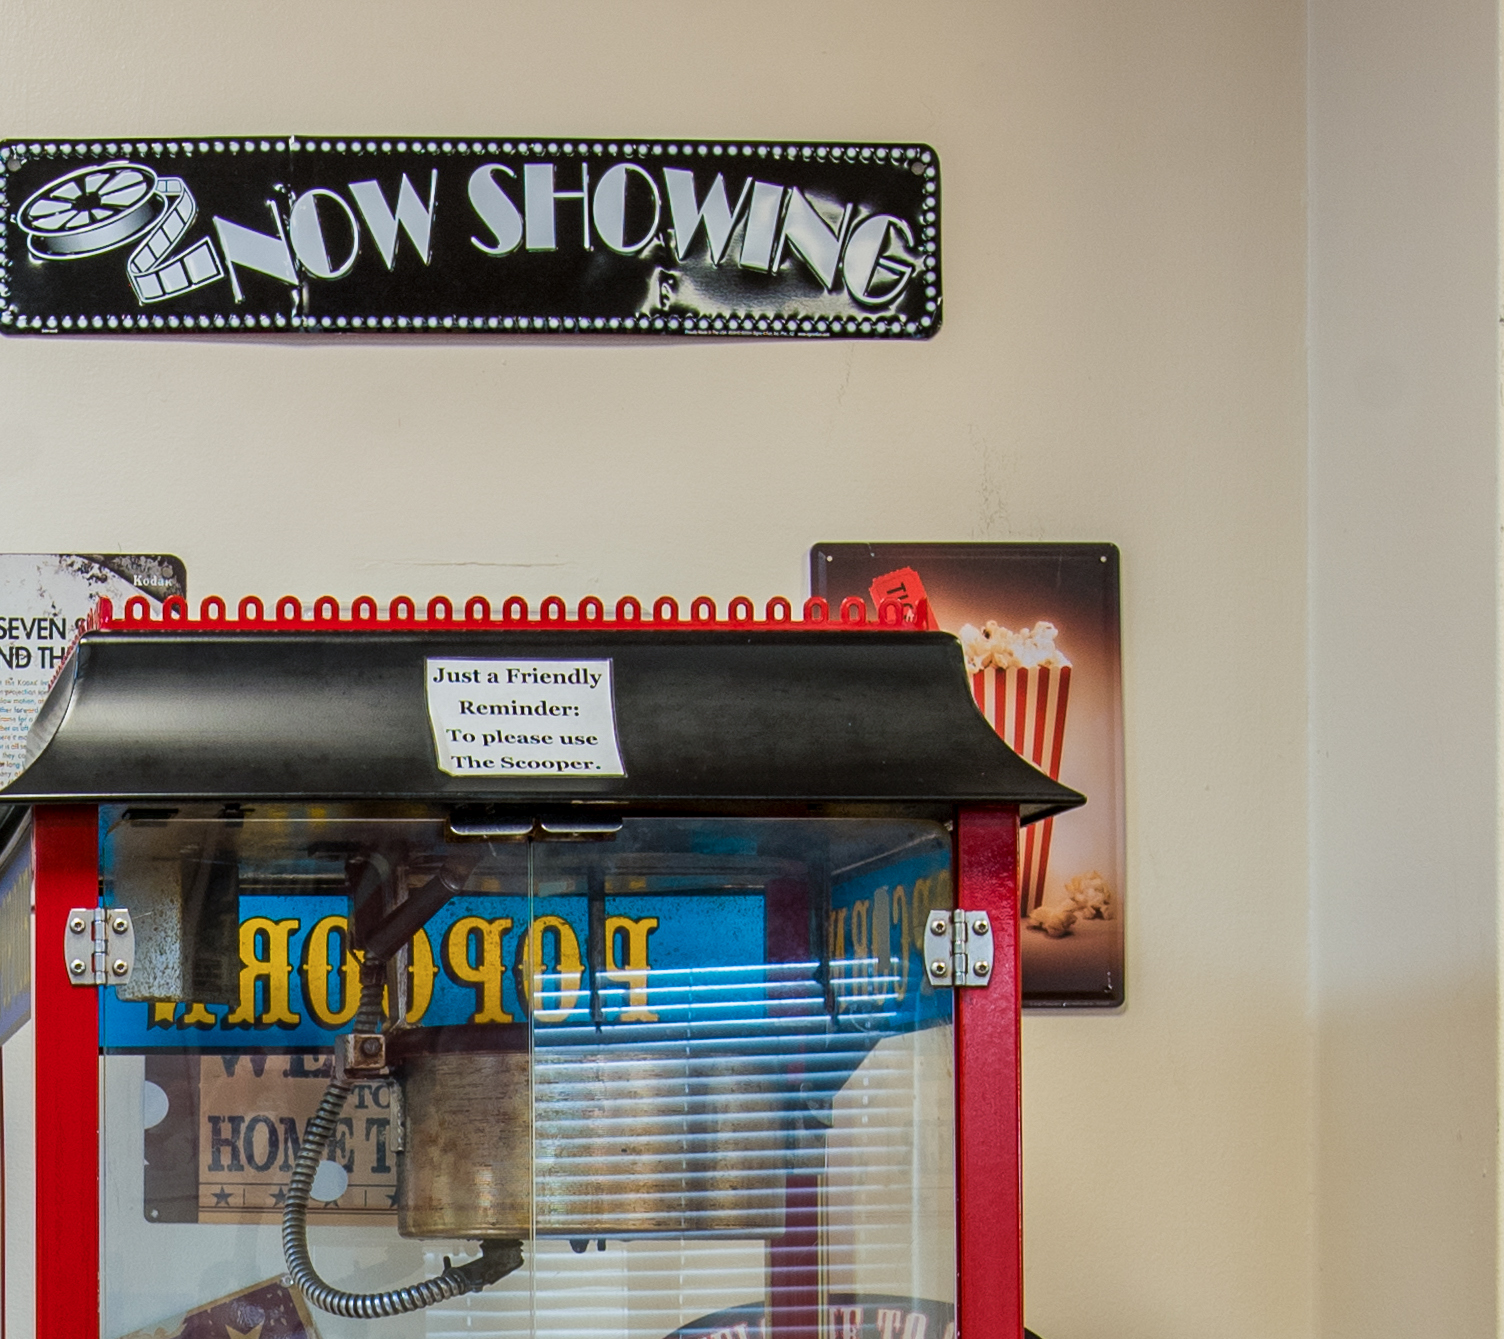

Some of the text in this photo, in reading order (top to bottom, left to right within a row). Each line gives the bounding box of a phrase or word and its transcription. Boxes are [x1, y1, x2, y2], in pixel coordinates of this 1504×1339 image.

[212, 161, 919, 306] NOW SHOWING
[133, 574, 173, 586] Kodak
[432, 667, 602, 689] Just a Friendly
[458, 700, 580, 717] Reminder:
[446, 728, 599, 747] To please use
[451, 755, 601, 772] The Scooper.
